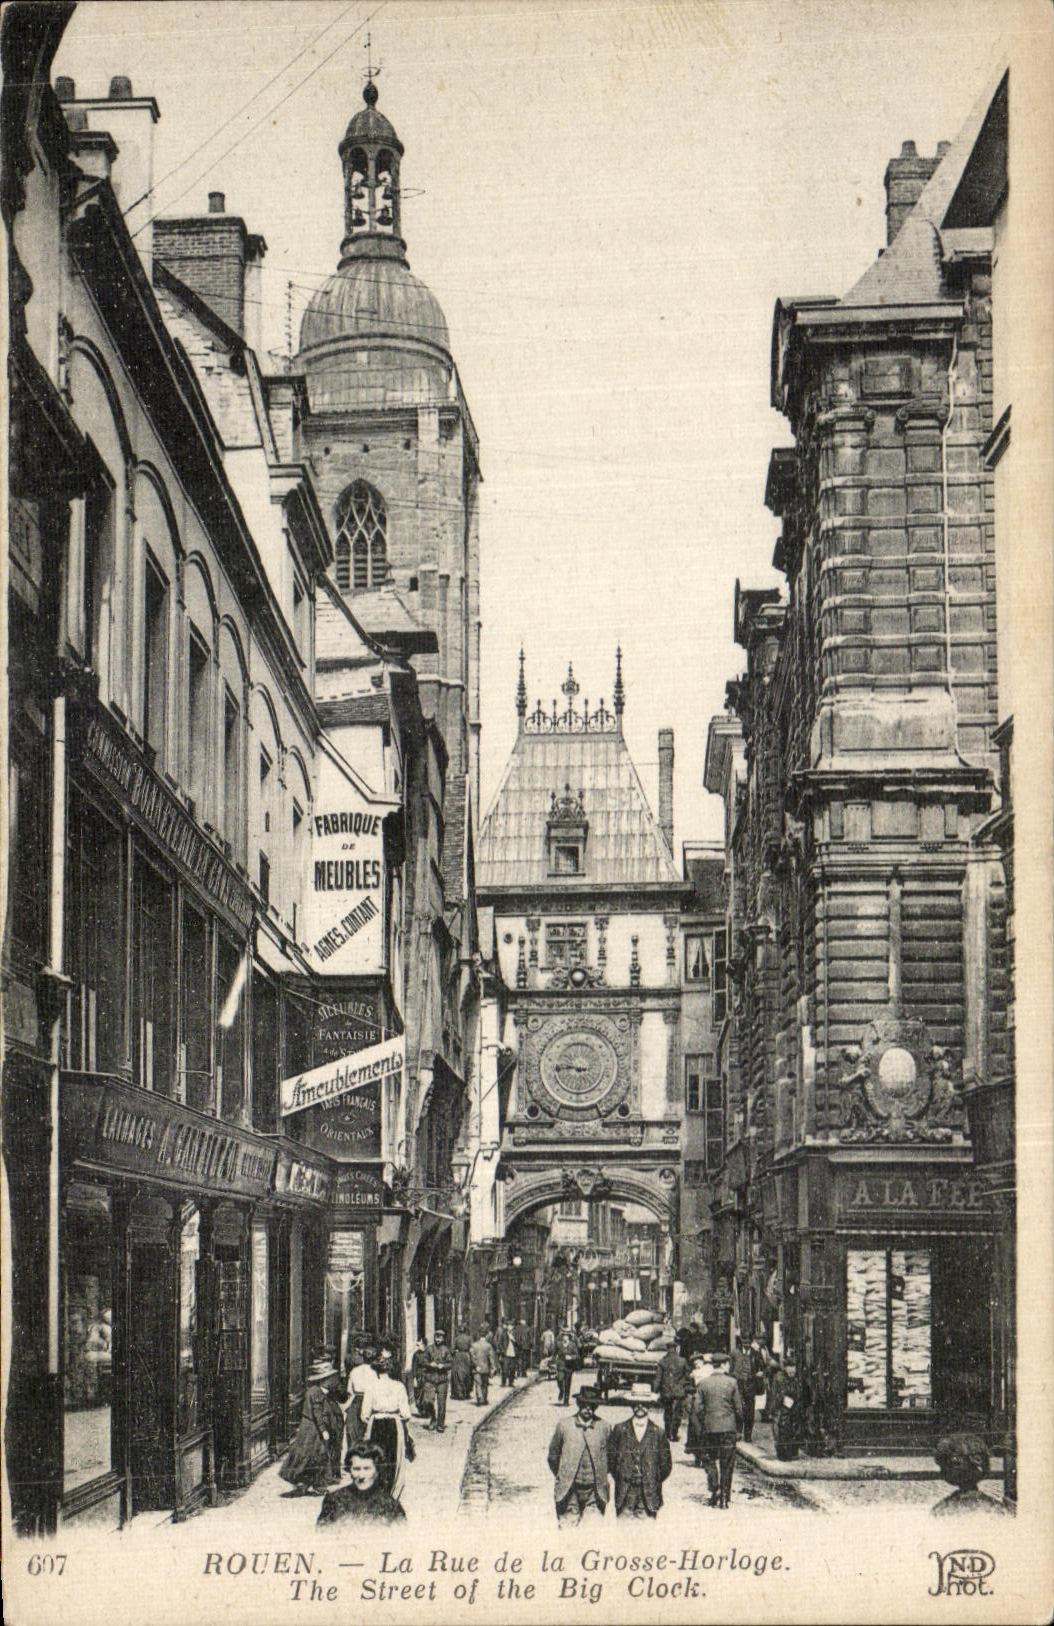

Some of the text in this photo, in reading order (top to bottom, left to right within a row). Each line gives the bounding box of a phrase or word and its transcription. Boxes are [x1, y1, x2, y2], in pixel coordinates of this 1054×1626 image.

[314, 812, 382, 837] FABRIQUE
[314, 860, 380, 891] MEUBLES
[319, 1029, 376, 1040] FANTAISIE
[283, 1050, 404, 1110] Ameublements
[320, 1123, 374, 1142] ORIENTAUX
[851, 1180, 874, 1206] A
